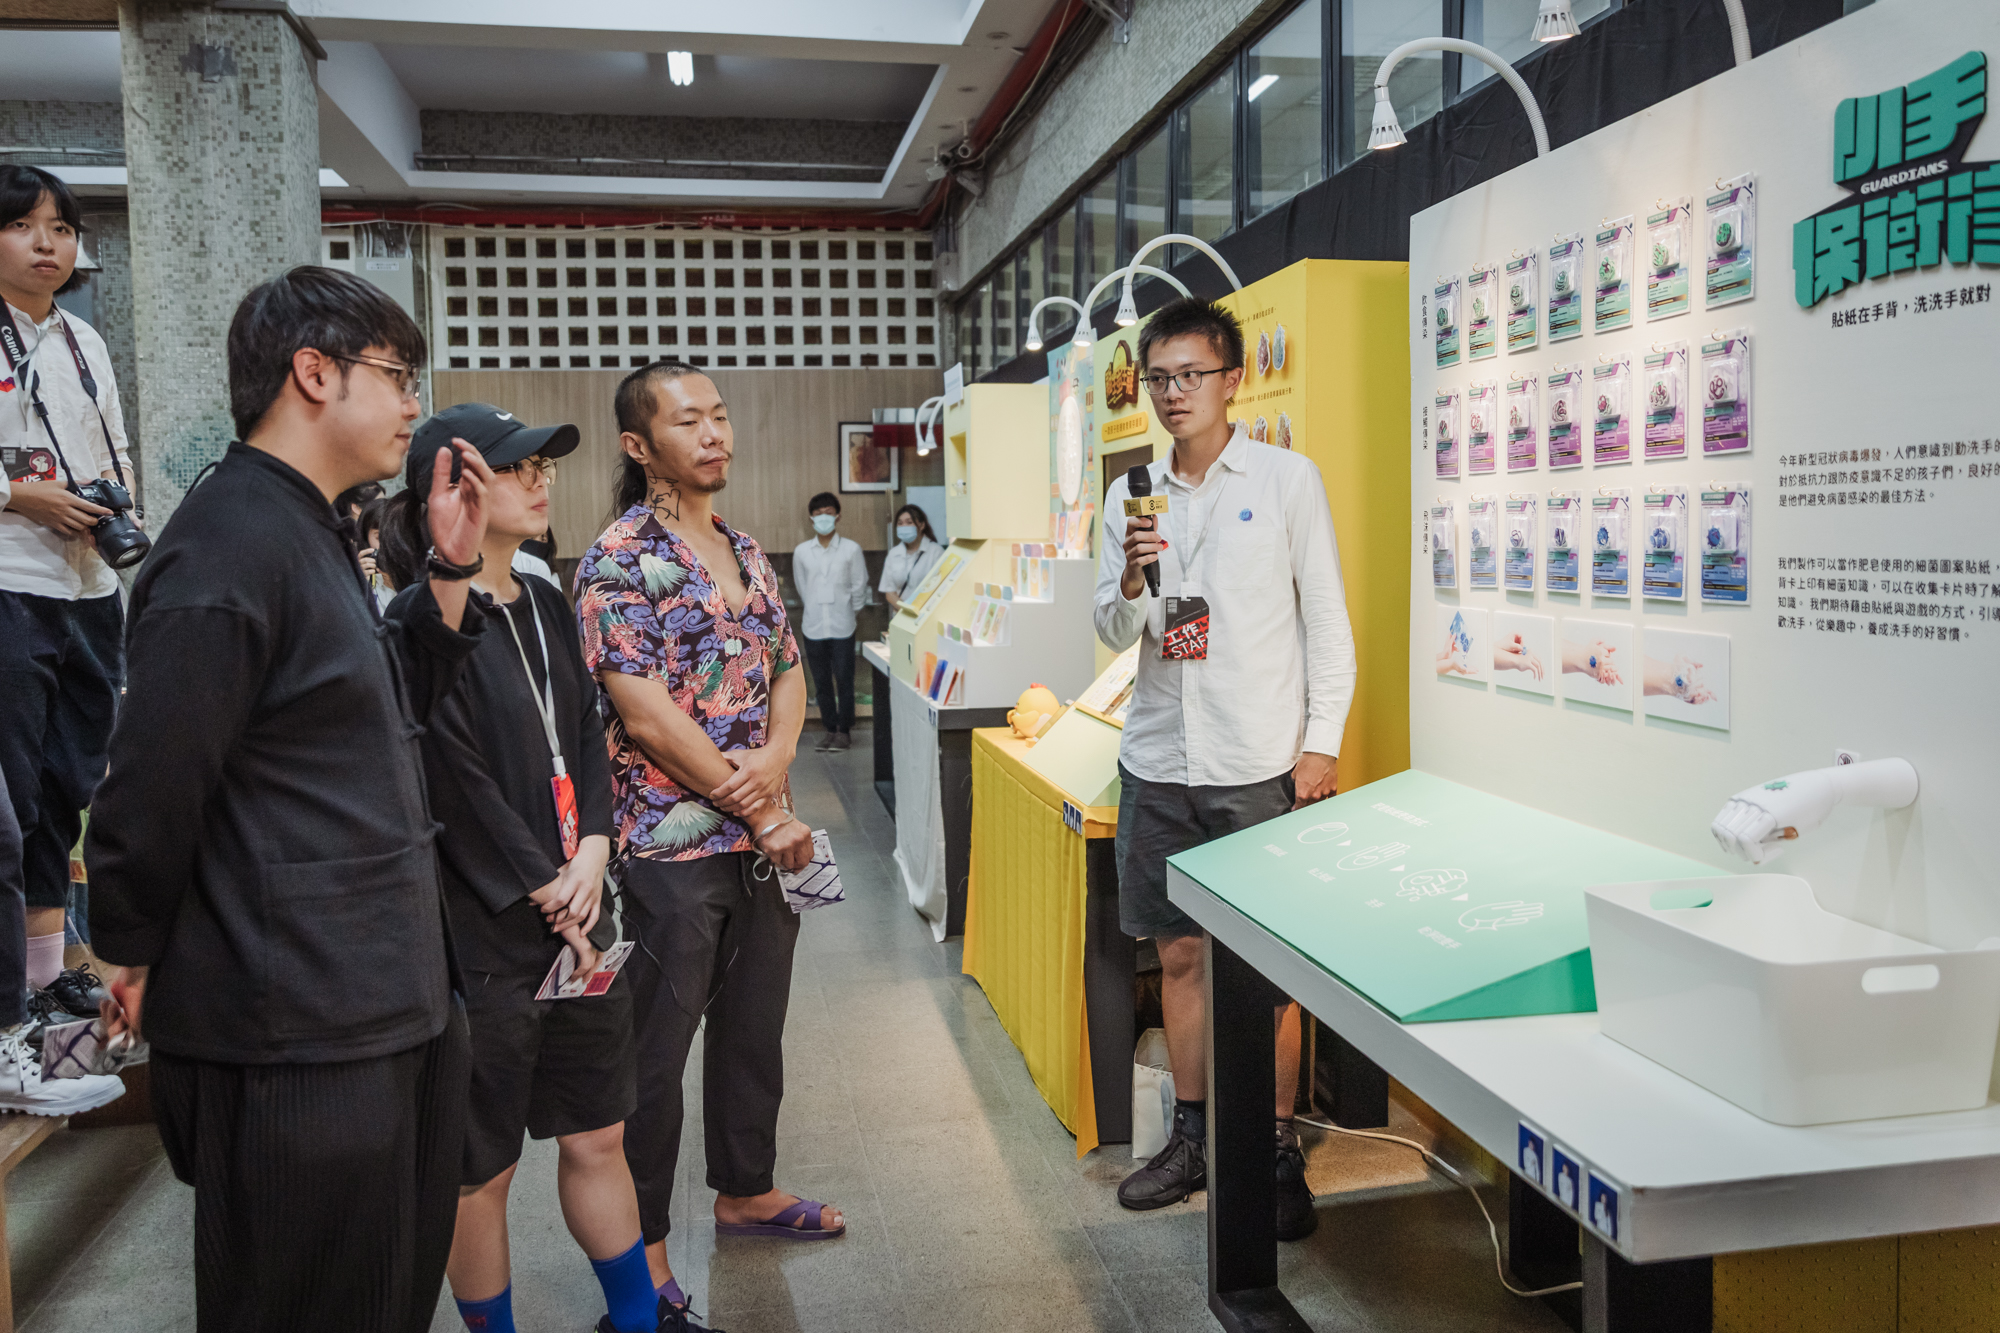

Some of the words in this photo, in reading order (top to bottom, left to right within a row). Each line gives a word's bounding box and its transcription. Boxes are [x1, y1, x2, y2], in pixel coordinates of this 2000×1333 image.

[1833, 50, 1986, 184] 小手
[1860, 159, 1950, 195] GUARDIANS
[1831, 282, 1992, 329] 貼紙在手背，洗洗手就對
[1, 325, 22, 363] Canon
[1165, 622, 1199, 647] 工作
